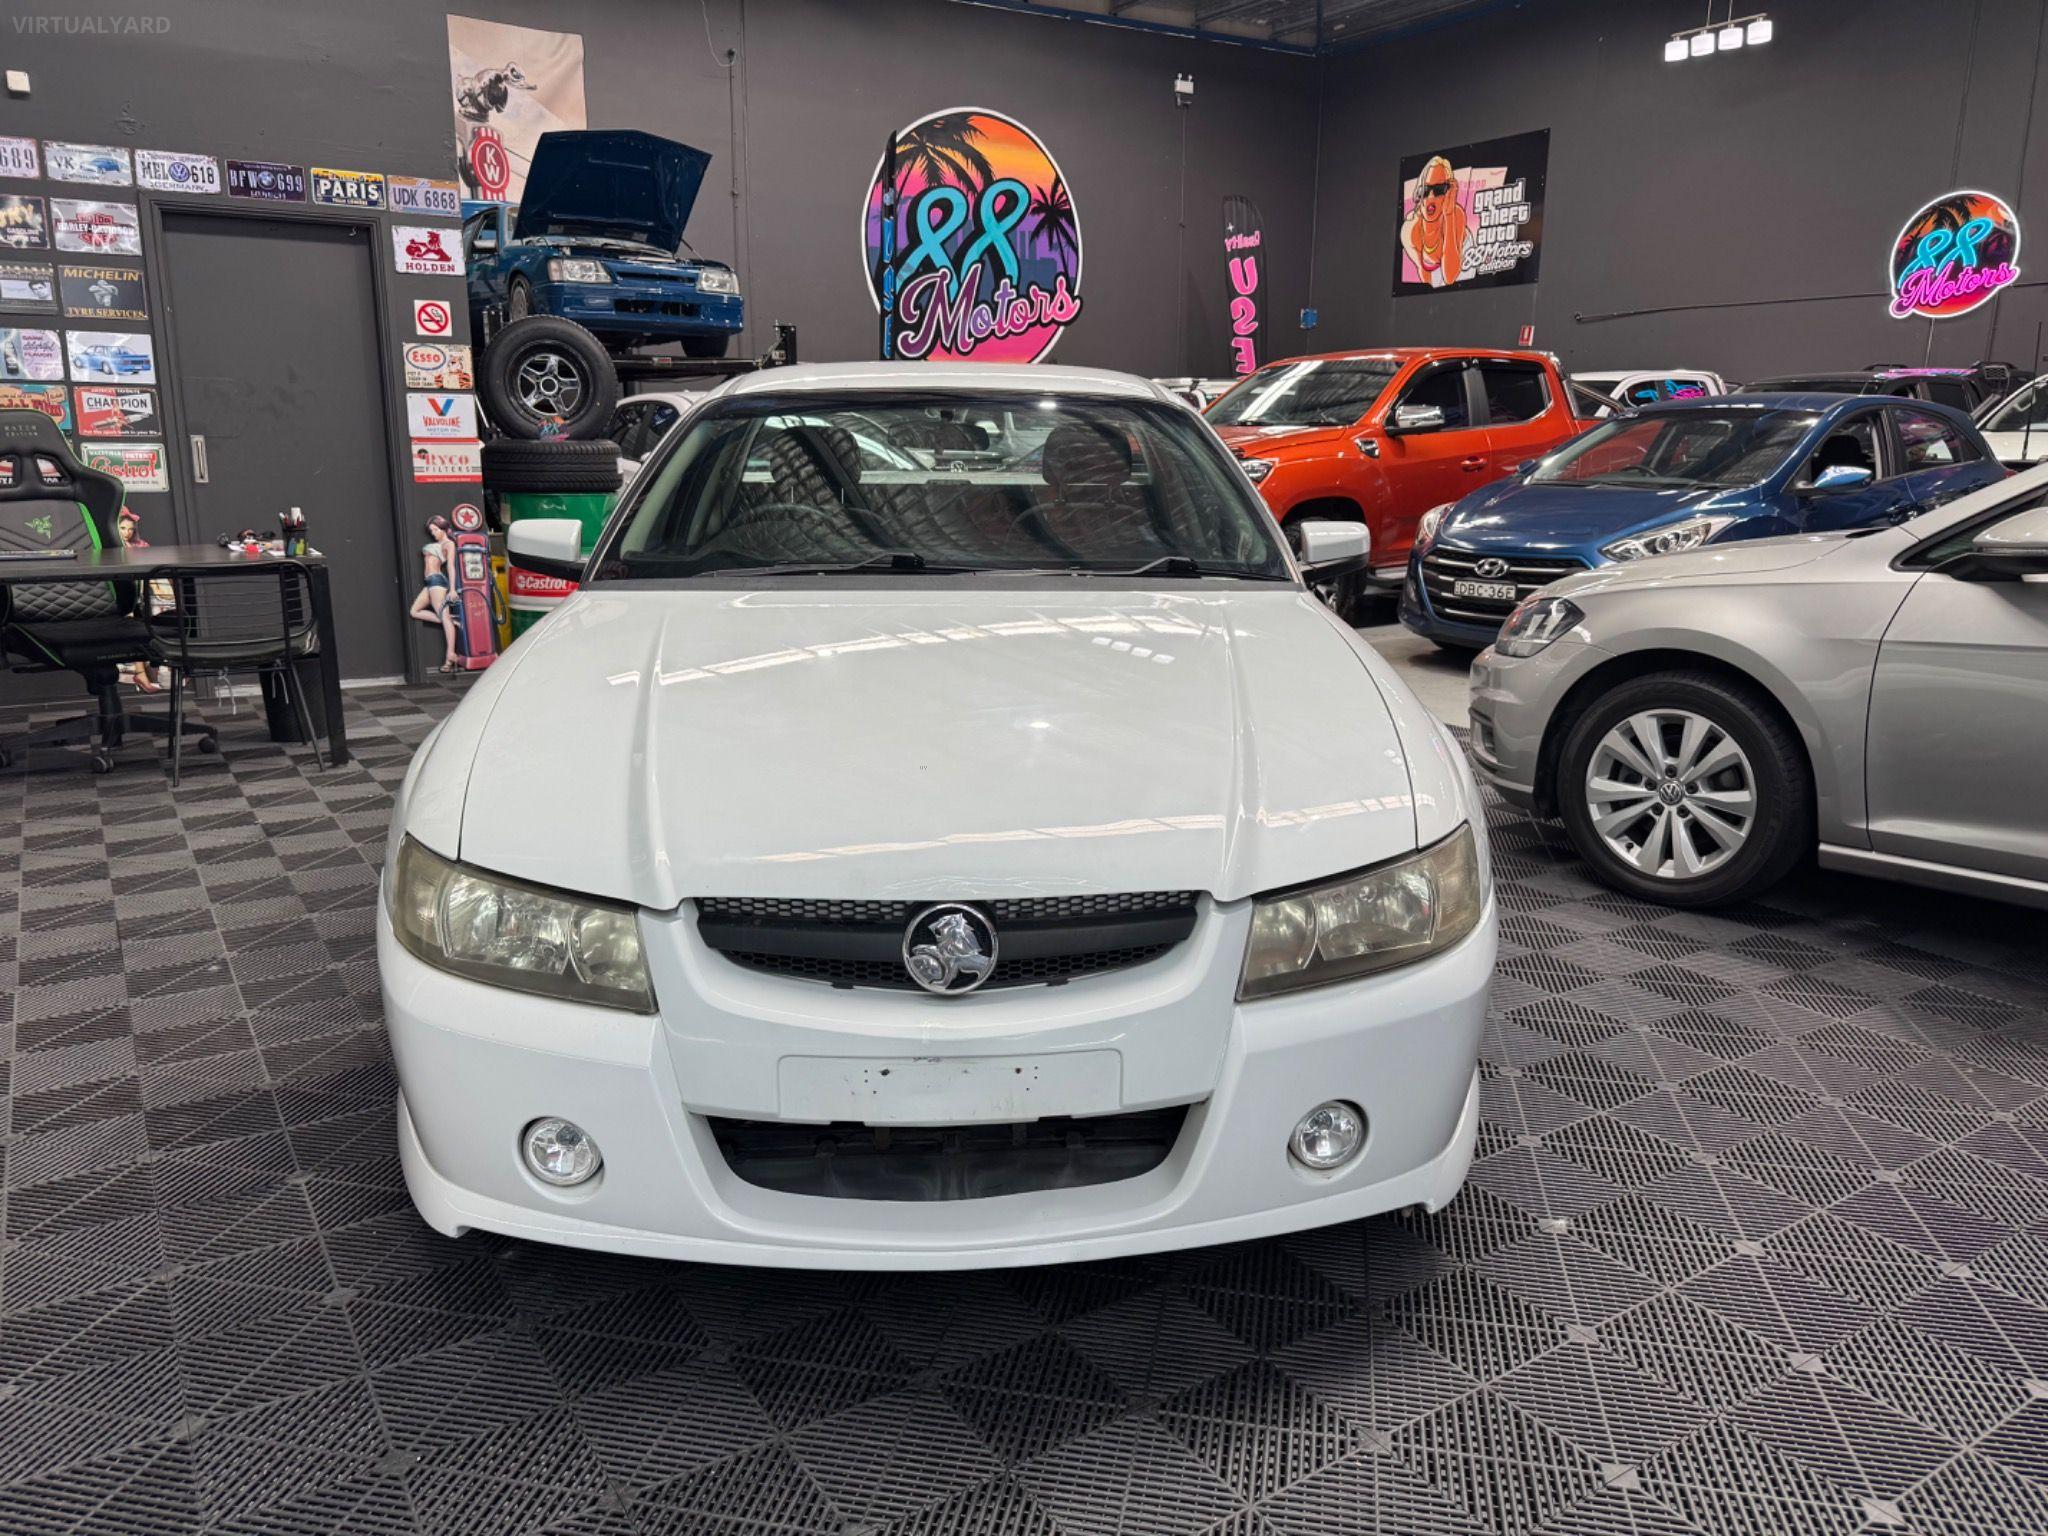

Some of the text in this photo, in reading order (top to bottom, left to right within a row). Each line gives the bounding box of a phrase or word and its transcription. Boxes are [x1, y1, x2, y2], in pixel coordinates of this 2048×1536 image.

[191, 165, 215, 184] 618
[277, 173, 303, 192] 699
[319, 179, 379, 200] PARIS
[393, 187, 455, 210] UDK 6868
[57, 222, 134, 236] HARLEY-DAVIDSON
[895, 177, 1030, 300] 88
[1897, 217, 1994, 289] 88
[64, 268, 139, 281] MICHELIN
[405, 262, 455, 272] HOLDEN
[1892, 261, 2017, 314] Motors
[67, 307, 145, 318] TYRE SERVICES
[898, 262, 1081, 357] Motors
[86, 396, 148, 409] CHAMPION
[423, 415, 461, 428] VALVOLINE
[90, 453, 157, 478] Castrol
[425, 454, 470, 466] RYCO
[526, 575, 567, 590] Castrol
